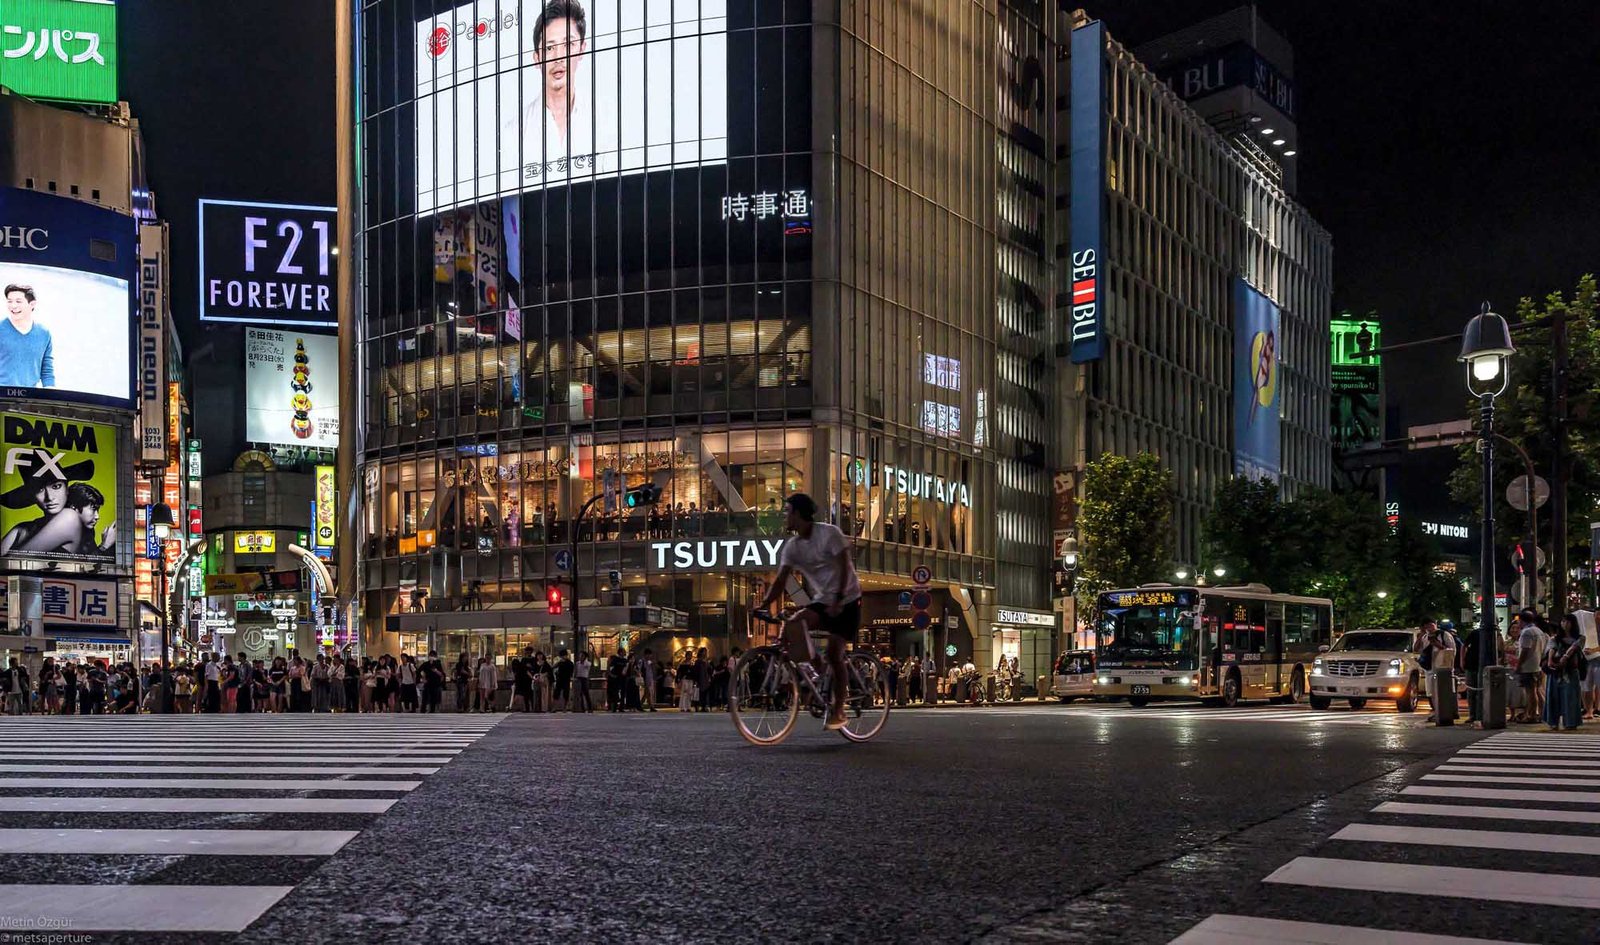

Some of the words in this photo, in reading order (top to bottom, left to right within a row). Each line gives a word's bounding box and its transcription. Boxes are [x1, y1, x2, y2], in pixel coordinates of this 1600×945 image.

[4, 25, 104, 66] ンパス
[722, 189, 813, 221] 時事通
[244, 216, 329, 276] F21
[210, 279, 331, 312] FOREVER
[1072, 248, 1096, 343] SEIBU
[143, 336, 157, 401] neon
[7, 387, 27, 397] DHC
[4, 416, 98, 454] DMM
[4, 447, 68, 480] FX
[883, 465, 970, 507] TSUTAYA
[320, 528, 331, 537] 4F
[1440, 524, 1469, 539] NITORI
[872, 617, 913, 625] STARBUCKS
[997, 609, 1028, 623] TSUTAYA
